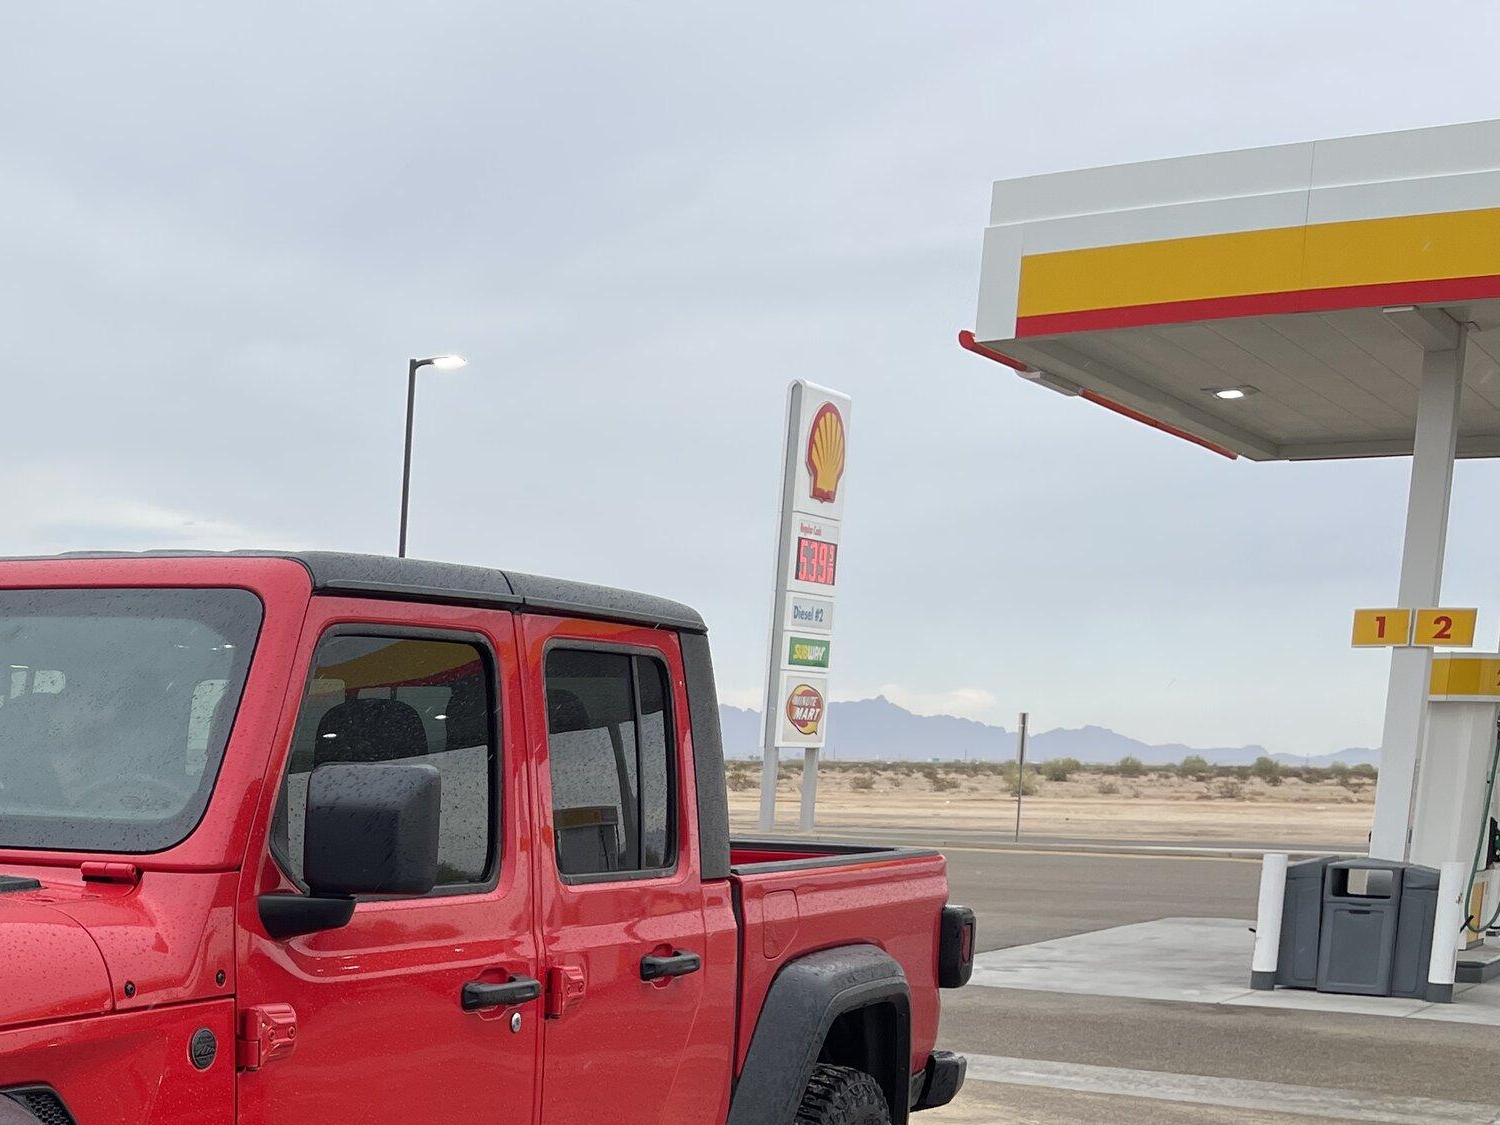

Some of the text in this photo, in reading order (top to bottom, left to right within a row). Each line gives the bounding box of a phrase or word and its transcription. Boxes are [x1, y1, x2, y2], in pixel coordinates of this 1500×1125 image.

[793, 605, 824, 622] Diesel #2
[1375, 615, 1452, 639] 1 2
[793, 644, 826, 661] SUBWAY
[792, 695, 819, 707] MINUTE
[794, 706, 821, 720] MART
